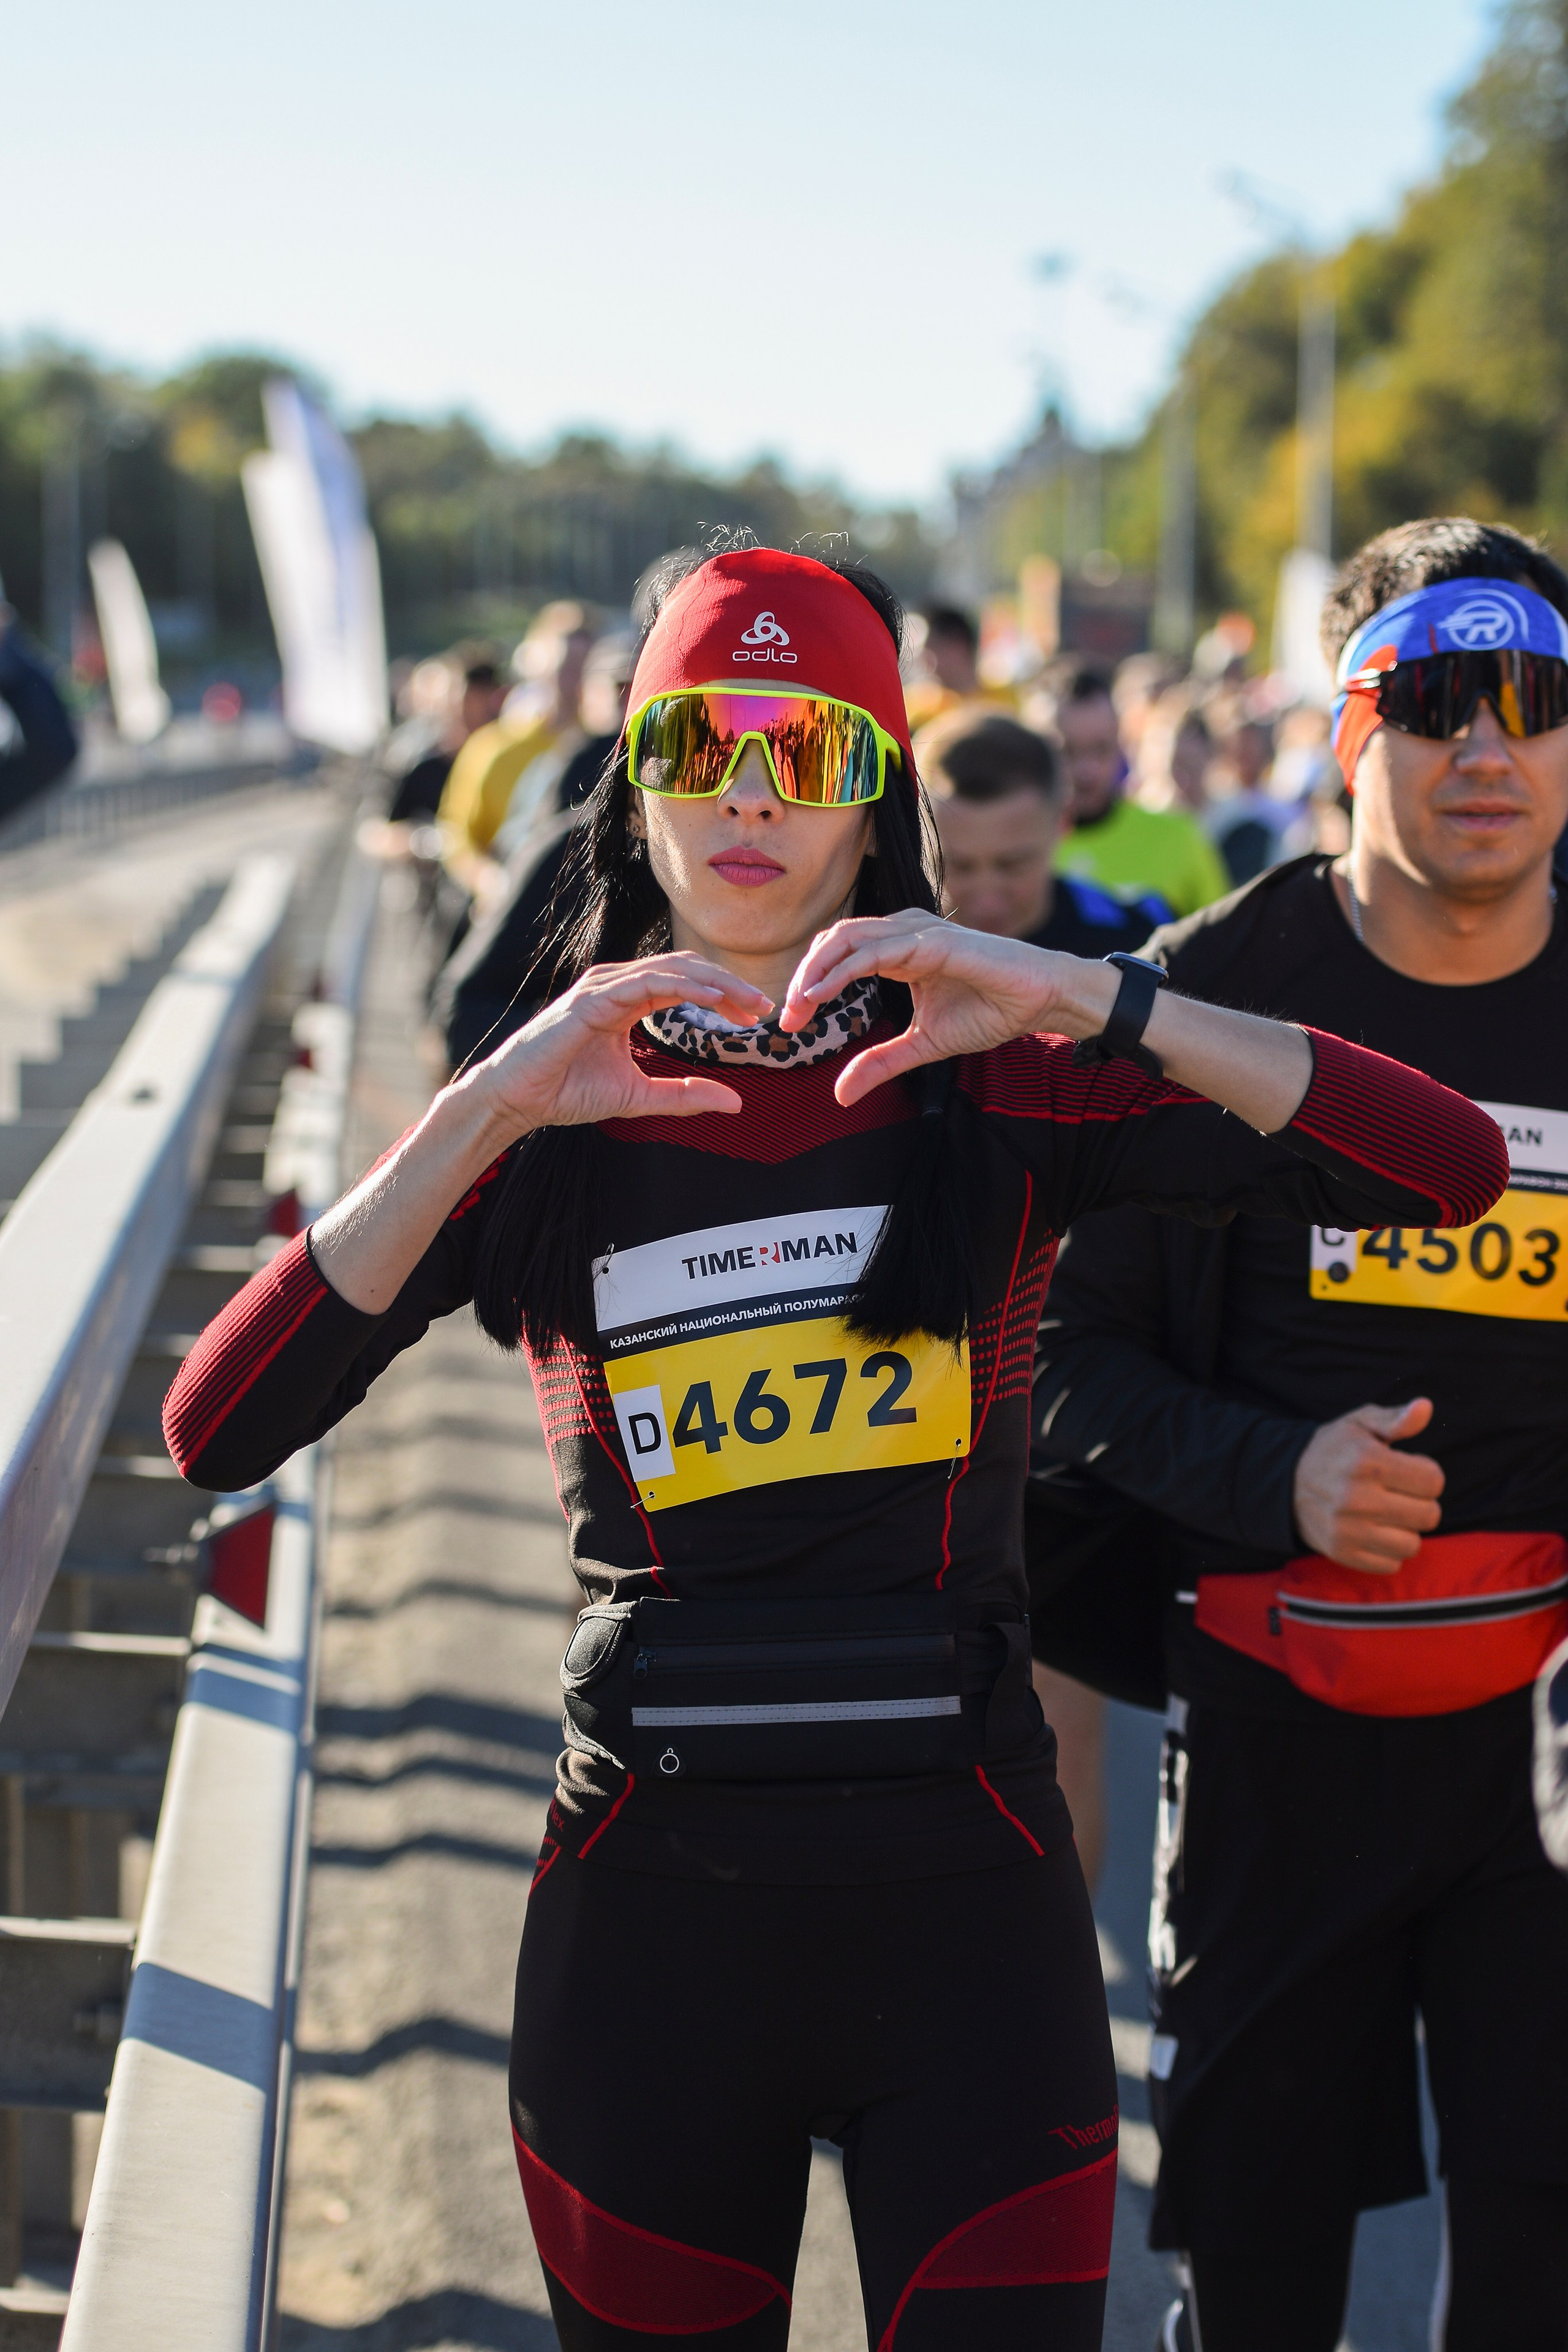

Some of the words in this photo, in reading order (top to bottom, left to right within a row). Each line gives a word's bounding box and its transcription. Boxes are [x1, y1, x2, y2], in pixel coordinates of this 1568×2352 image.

[732, 648, 797, 663] odlo
[682, 1232, 858, 1280] TIMERMAN
[1362, 1223, 1560, 1287] 4503
[610, 1323, 678, 1349] КАЗАНСКИЙ
[679, 1303, 782, 1333] НАЦИОНАЛЬНЫЙ
[628, 1411, 662, 1455] D
[673, 1351, 918, 1454] 4672
